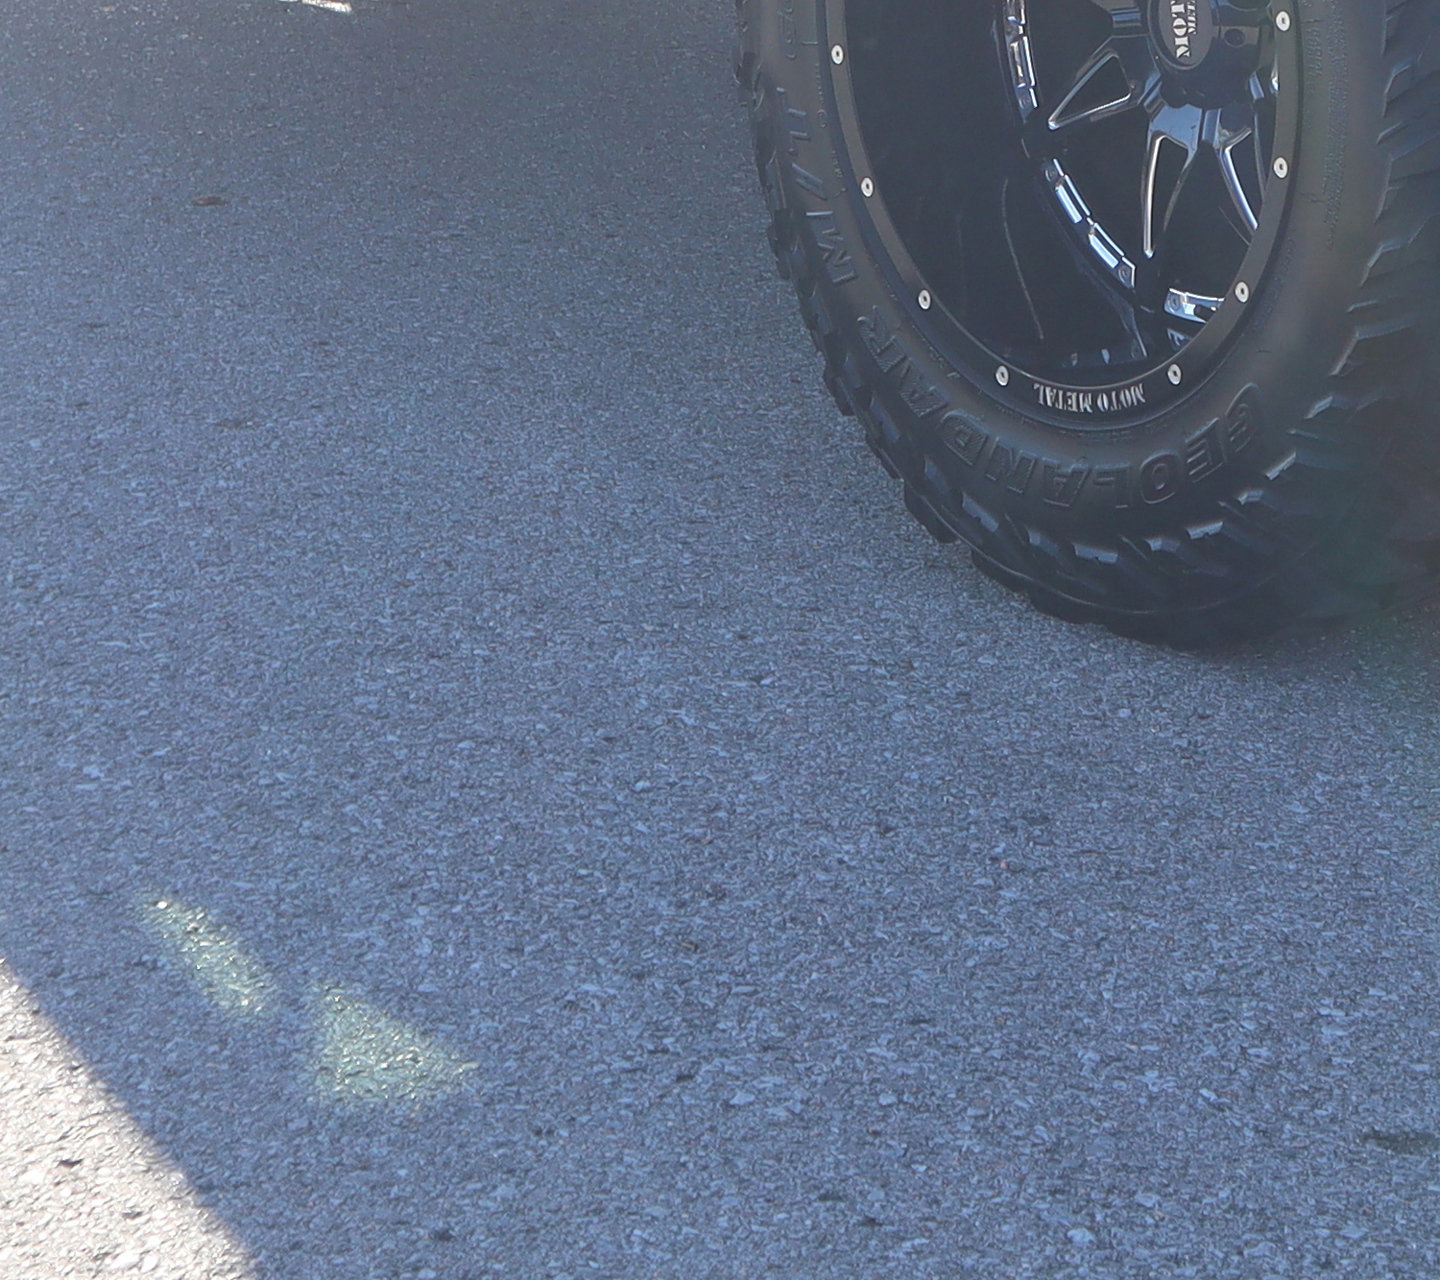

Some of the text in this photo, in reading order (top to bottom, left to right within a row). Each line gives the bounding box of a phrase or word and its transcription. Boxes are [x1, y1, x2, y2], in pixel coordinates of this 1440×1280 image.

[857, 305, 1263, 508] GEOLANDAR
[1033, 382, 1147, 414] MOTO METAL
